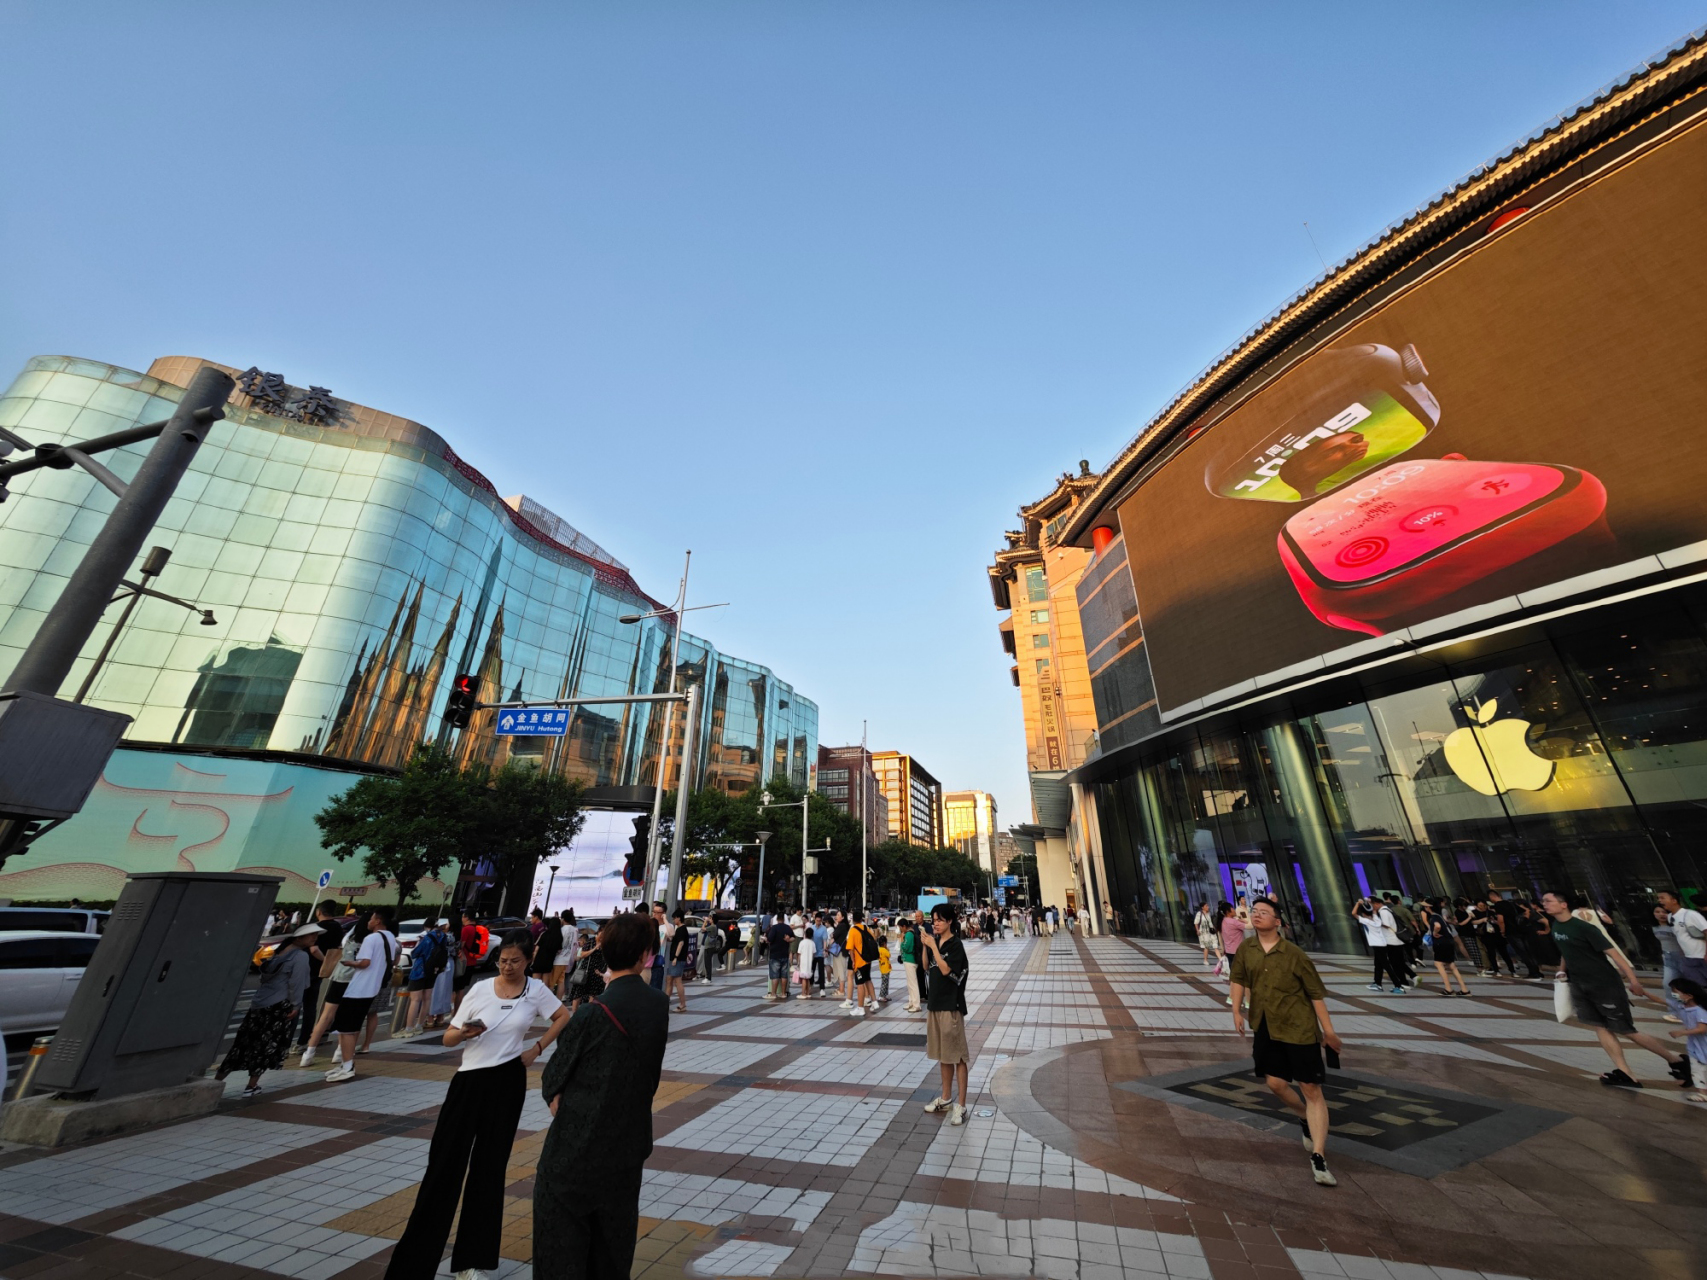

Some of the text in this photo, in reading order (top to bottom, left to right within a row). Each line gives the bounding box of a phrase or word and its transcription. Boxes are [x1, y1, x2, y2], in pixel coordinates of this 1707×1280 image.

[236, 366, 339, 416] 银泰
[1342, 465, 1426, 505] 10:09
[1413, 511, 1444, 526] 10%
[516, 712, 567, 724] 金鱼胡同
[537, 725, 563, 733] Hutong
